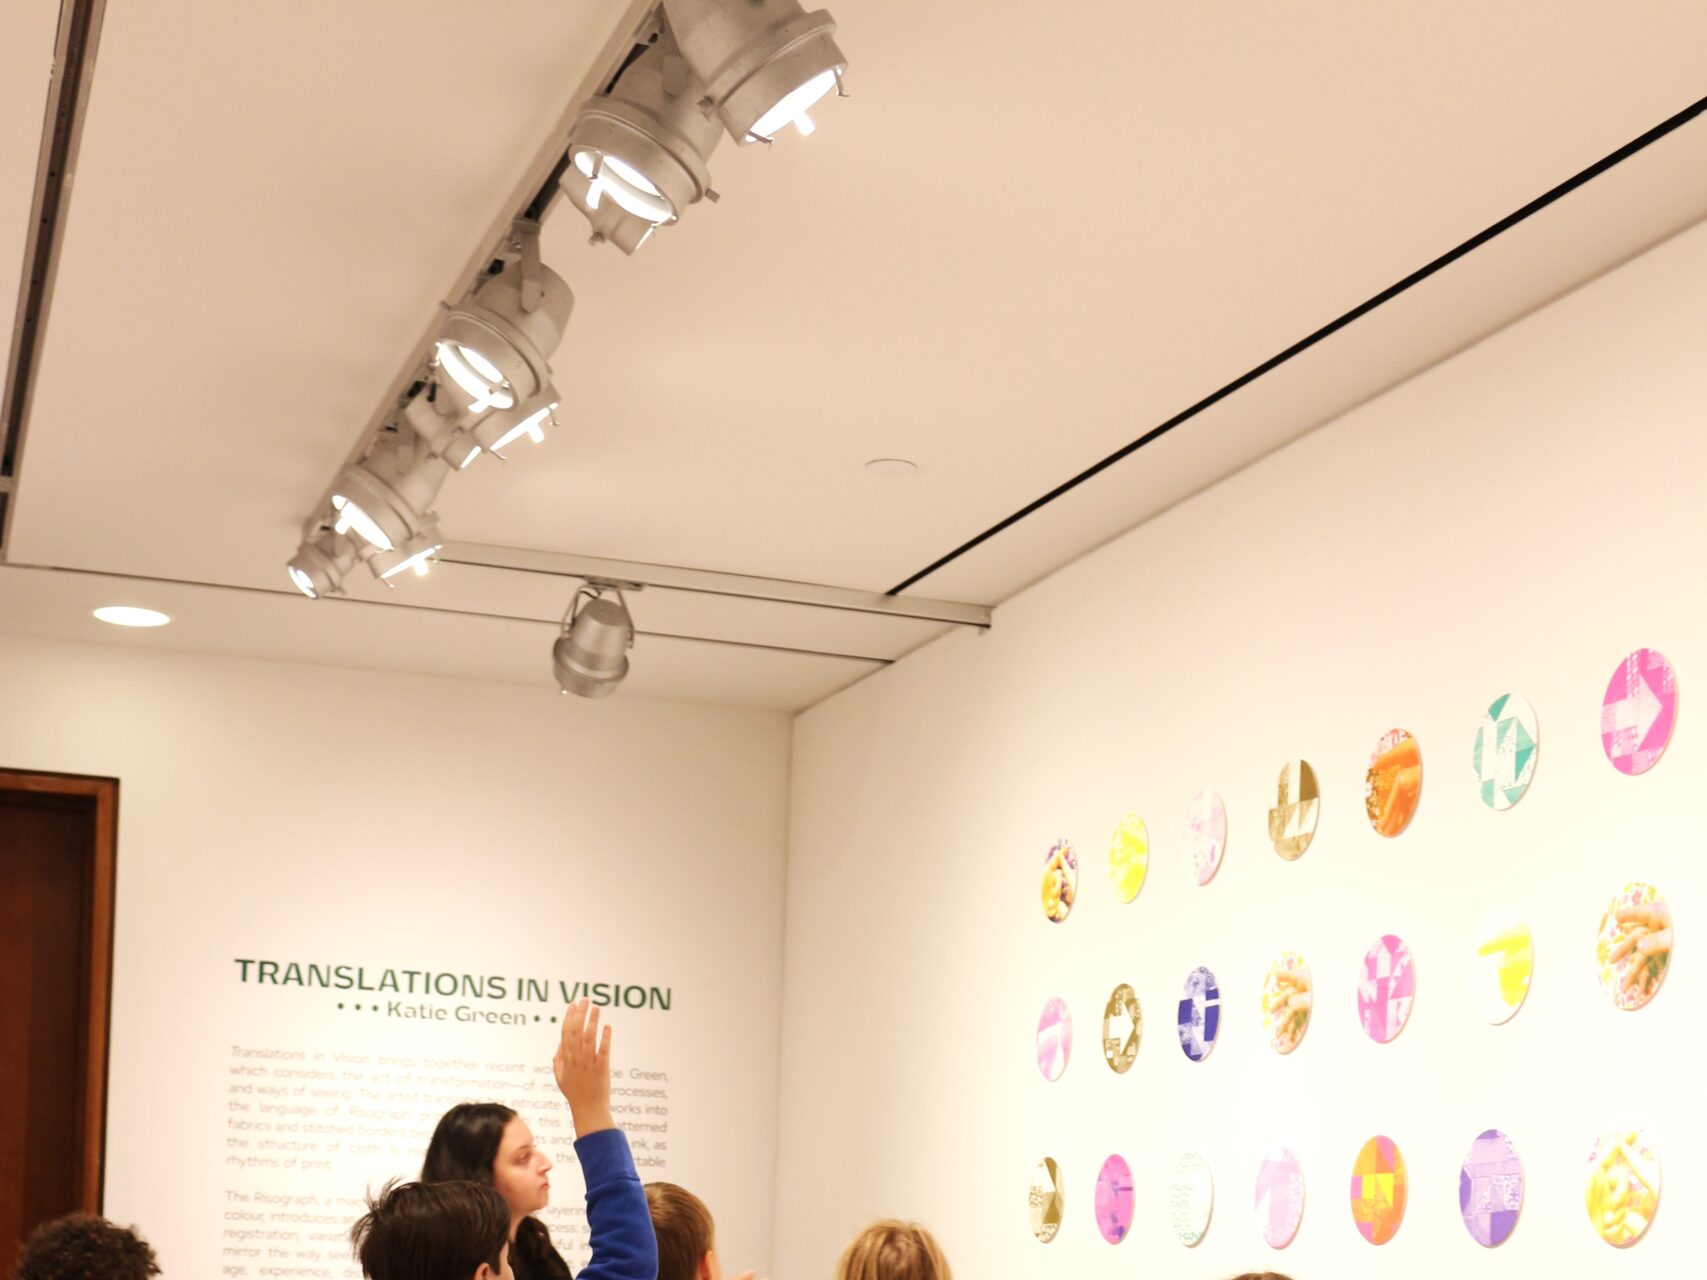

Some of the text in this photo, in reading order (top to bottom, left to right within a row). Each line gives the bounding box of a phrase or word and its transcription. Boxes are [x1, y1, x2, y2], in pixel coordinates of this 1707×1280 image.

[234, 958, 672, 1011] TRANSLATIONS IN VISION
[388, 1001, 527, 1026] Katie Green
[230, 1065, 268, 1077] which
[274, 1068, 335, 1080] considers
[232, 1045, 306, 1061] Translations
[486, 1062, 526, 1074] recent
[630, 1068, 669, 1083] Green,
[228, 1101, 251, 1112] the
[259, 1102, 316, 1117] language
[326, 1104, 340, 1117] of
[229, 1084, 253, 1095] and
[257, 1087, 288, 1099] ways
[293, 1085, 306, 1097] of
[645, 1103, 668, 1116] into
[227, 1118, 272, 1131] fabrics
[275, 1121, 298, 1133] and
[550, 1134, 573, 1146] and
[653, 1141, 667, 1150] as
[226, 1137, 250, 1149] the
[257, 1139, 319, 1152] structure
[327, 1141, 340, 1153] of
[556, 1151, 576, 1163] the
[226, 1156, 280, 1170] rhythms
[284, 1157, 297, 1169] of
[225, 1190, 249, 1202] The
[270, 1212, 337, 1225] introduces
[223, 1247, 261, 1257] mirror
[268, 1247, 289, 1258] the
[296, 1251, 320, 1263] way
